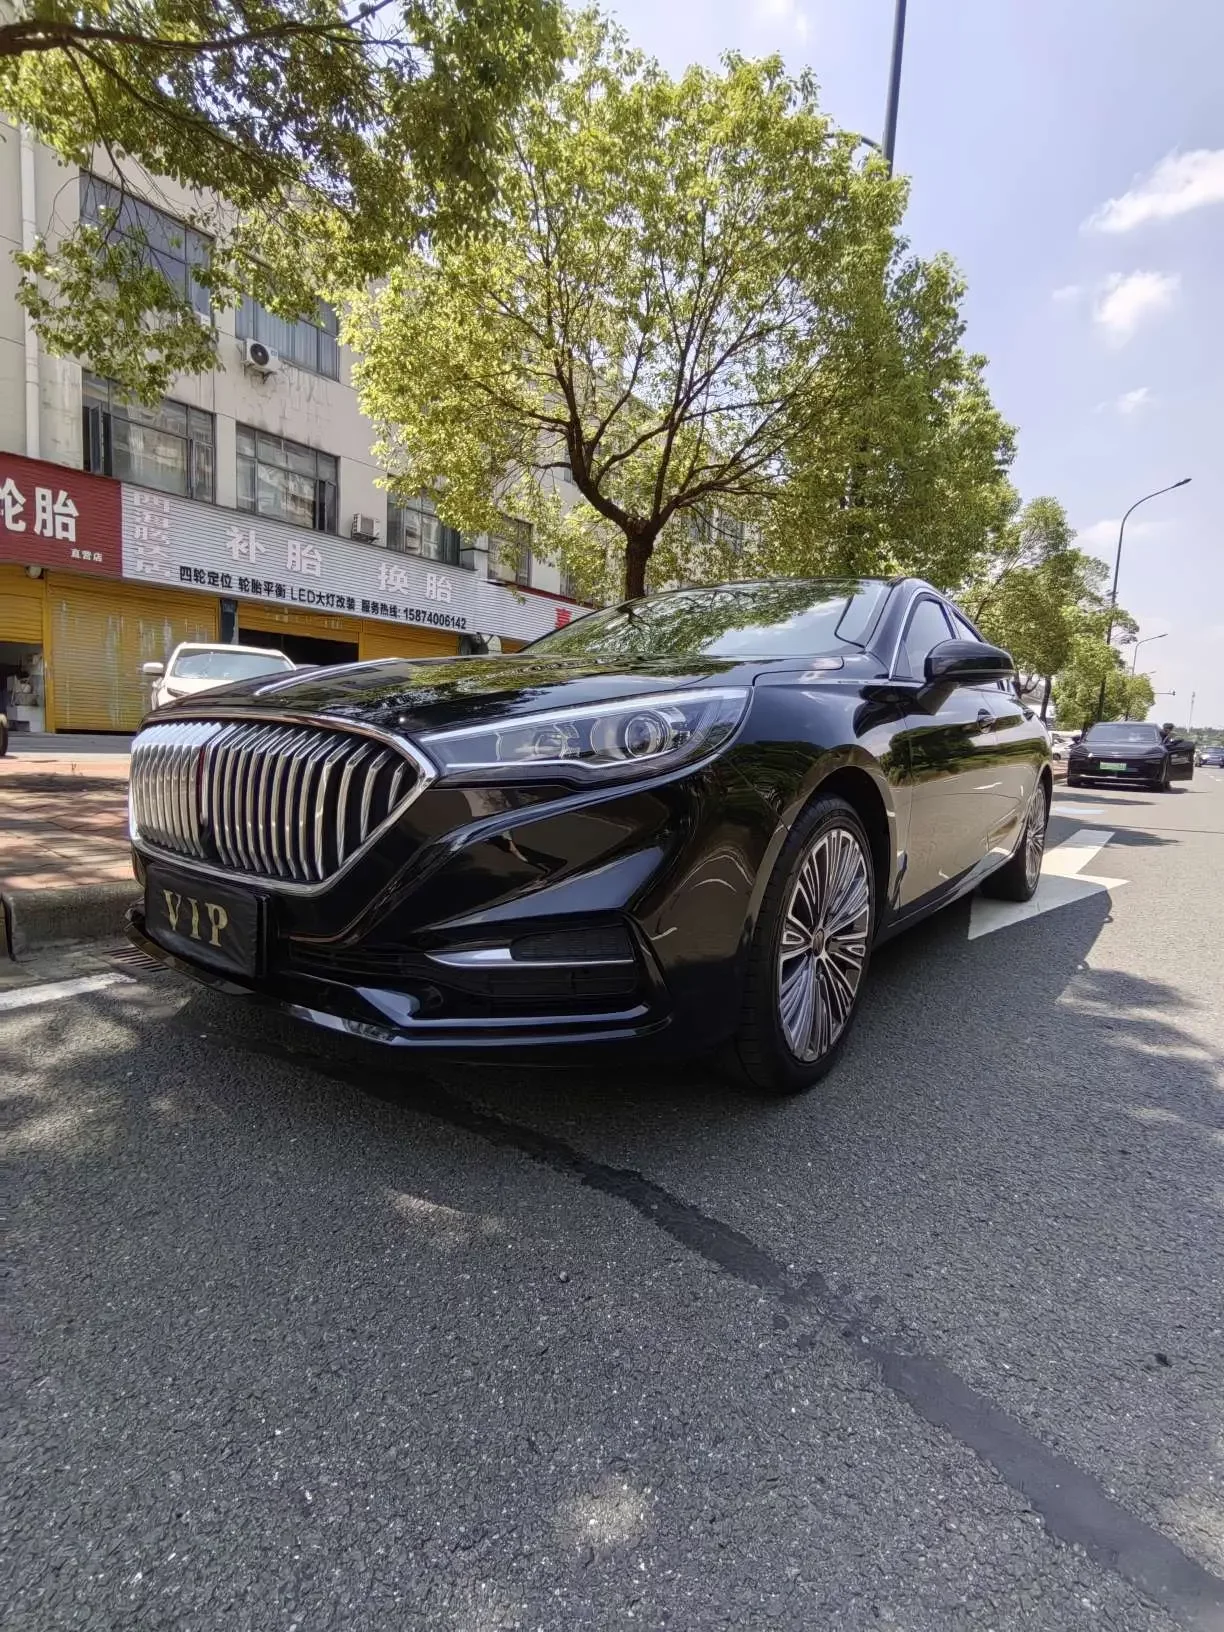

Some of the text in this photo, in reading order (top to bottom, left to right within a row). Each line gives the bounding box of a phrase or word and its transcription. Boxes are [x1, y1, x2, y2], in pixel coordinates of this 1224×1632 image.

[179, 565, 233, 589] 四轮定位
[238, 576, 286, 599] 轮胎平衡
[290, 588, 356, 611] LED大灯改装
[403, 607, 467, 630] 15874006142
[163, 889, 228, 947] VIP
